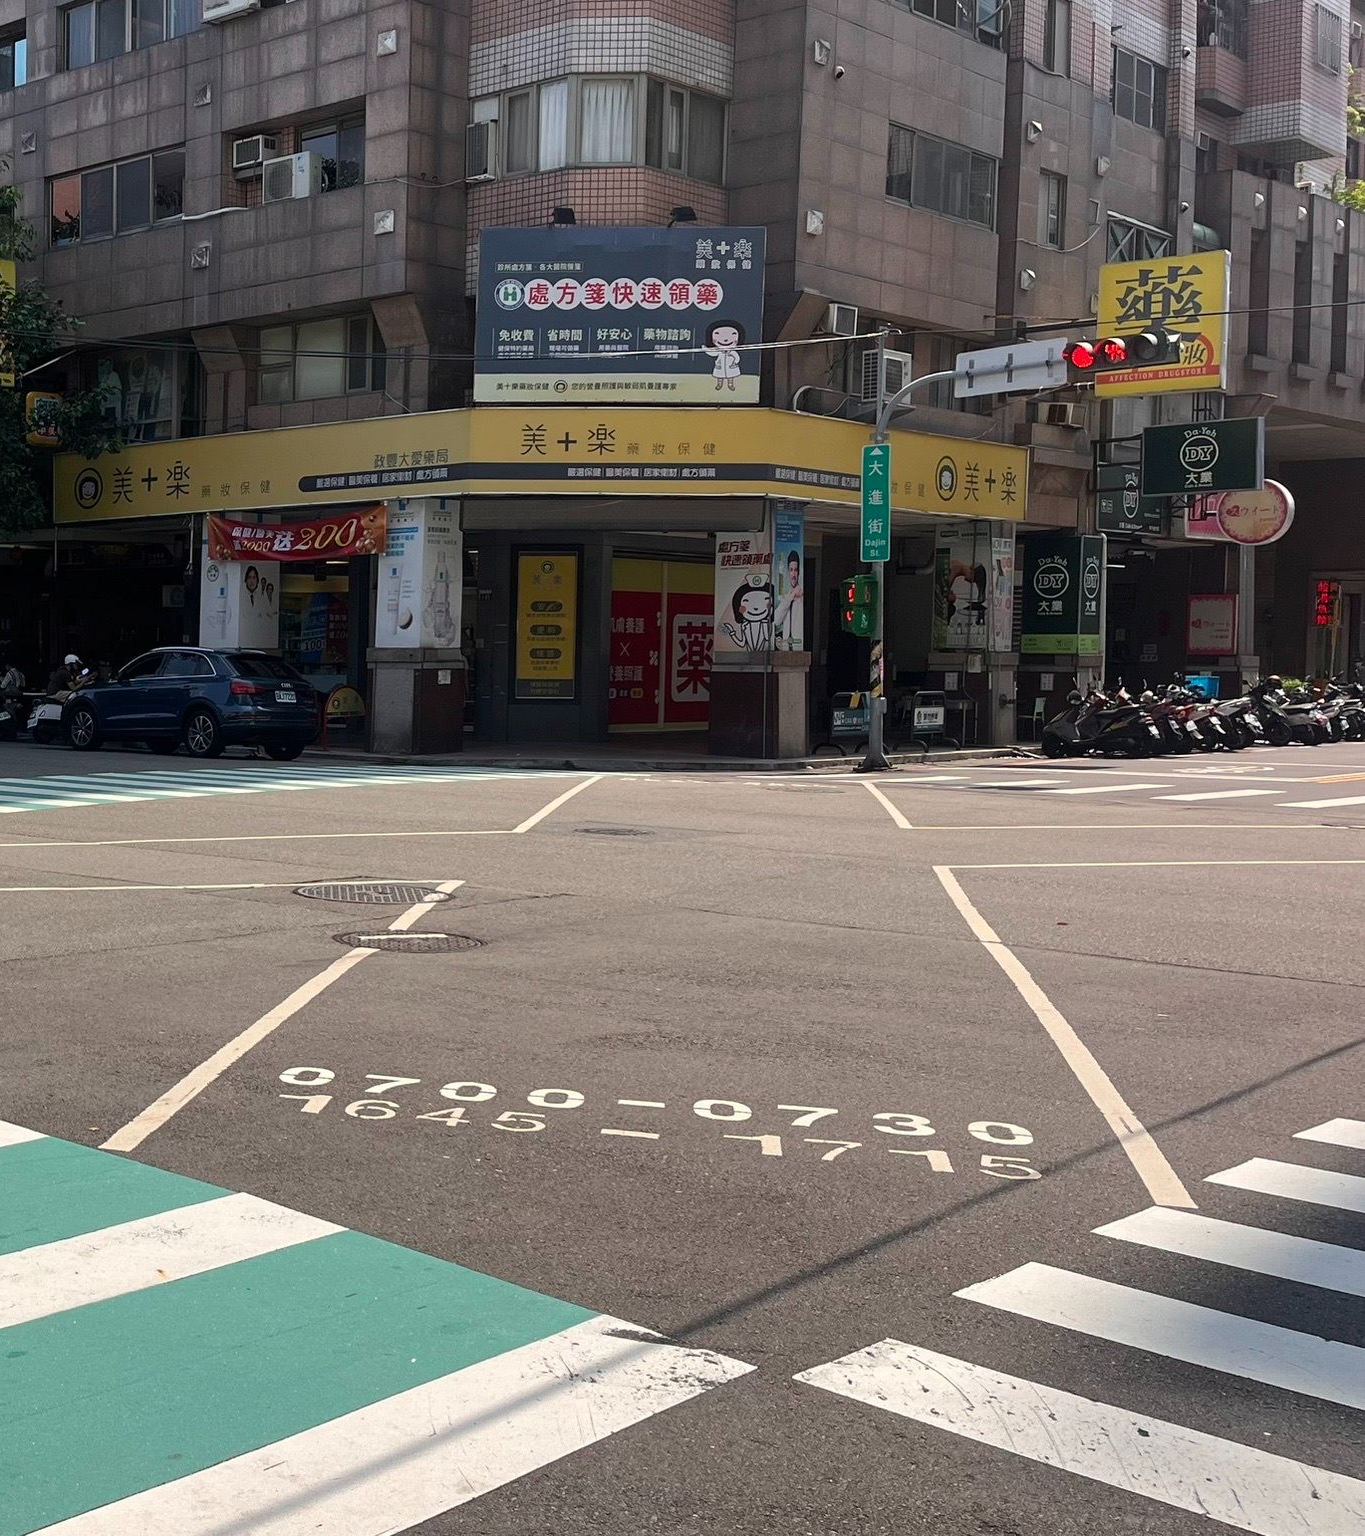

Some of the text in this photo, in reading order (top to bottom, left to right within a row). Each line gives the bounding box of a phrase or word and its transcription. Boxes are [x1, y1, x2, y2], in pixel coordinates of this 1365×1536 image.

[527, 282, 718, 305] 處方箋快速領藥
[498, 328, 691, 342] 免收費 省時間 好安心 藥物諮詢
[1109, 367, 1207, 383] AFFECTION DRUGSTORE
[1186, 446, 1214, 461] DY
[868, 461, 884, 535] 大進街
[272, 530, 295, 552] 送
[292, 518, 358, 551] 200
[865, 538, 886, 548] Dajin
[870, 549, 880, 557] St.
[1038, 574, 1064, 588] DY
